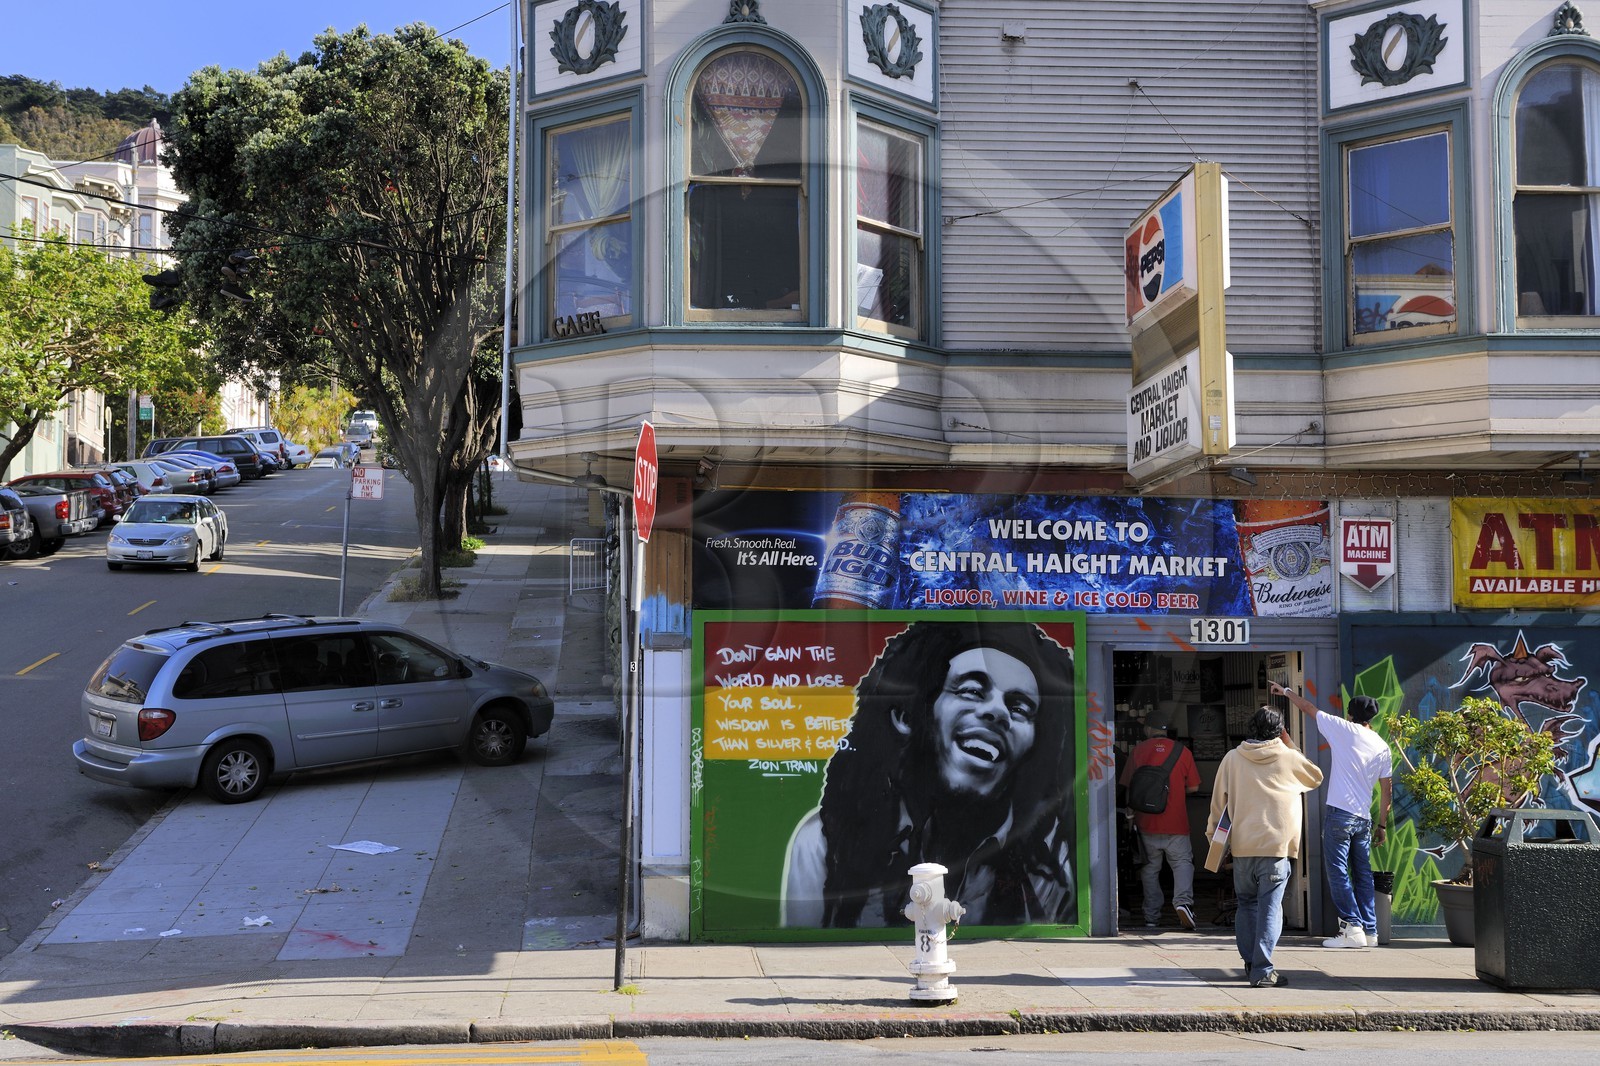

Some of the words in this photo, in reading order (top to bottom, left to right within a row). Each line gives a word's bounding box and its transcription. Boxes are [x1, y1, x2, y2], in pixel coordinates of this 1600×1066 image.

[1141, 239, 1165, 278] PEPSI
[552, 311, 607, 340] CAFE
[1130, 383, 1160, 415] CENTRAL
[1161, 365, 1188, 398] HAIGHT
[1141, 393, 1179, 436] MARKET
[1133, 435, 1152, 464] AND
[1155, 416, 1188, 453] LIQUOR
[353, 468, 364, 477] NO
[355, 478, 381, 486] PARKING
[636, 456, 656, 506] STOP
[989, 519, 1107, 541] WELCOME
[1115, 521, 1149, 542] TO
[1346, 525, 1389, 548] ATM
[758, 551, 779, 565] All
[780, 552, 818, 566] Here.
[832, 541, 893, 568] BUD
[909, 551, 1018, 573] CENTRAL
[1027, 553, 1121, 575] HAIGHT
[1129, 555, 1228, 577] MARKET
[1347, 550, 1387, 559] MACHINE
[1472, 579, 1576, 593] AVAILABLE
[925, 588, 998, 608] LIQUOR,
[1002, 589, 1048, 606] WINE
[1053, 590, 1070, 606] &
[1075, 591, 1100, 607] ICE
[1105, 591, 1152, 608] COLD
[1156, 592, 1199, 609] BEER
[1193, 620, 1246, 643] 1301
[716, 644, 763, 665] DONT
[764, 645, 802, 662] GAIN
[805, 645, 837, 663] THE
[631, 662, 636, 671] 3
[714, 672, 765, 690] WORLD
[771, 673, 801, 689] AND
[806, 673, 845, 688] LOSE
[718, 694, 753, 712] YOUR
[760, 696, 802, 711] SOUL,
[716, 718, 770, 731] WISDOM
[781, 719, 796, 730] IS
[804, 716, 855, 733] BETTER
[712, 737, 749, 752] THAN
[756, 738, 802, 752] SILVER
[748, 759, 780, 772] ZION
[780, 760, 818, 774] TRAIN
[920, 934, 931, 953] 8
